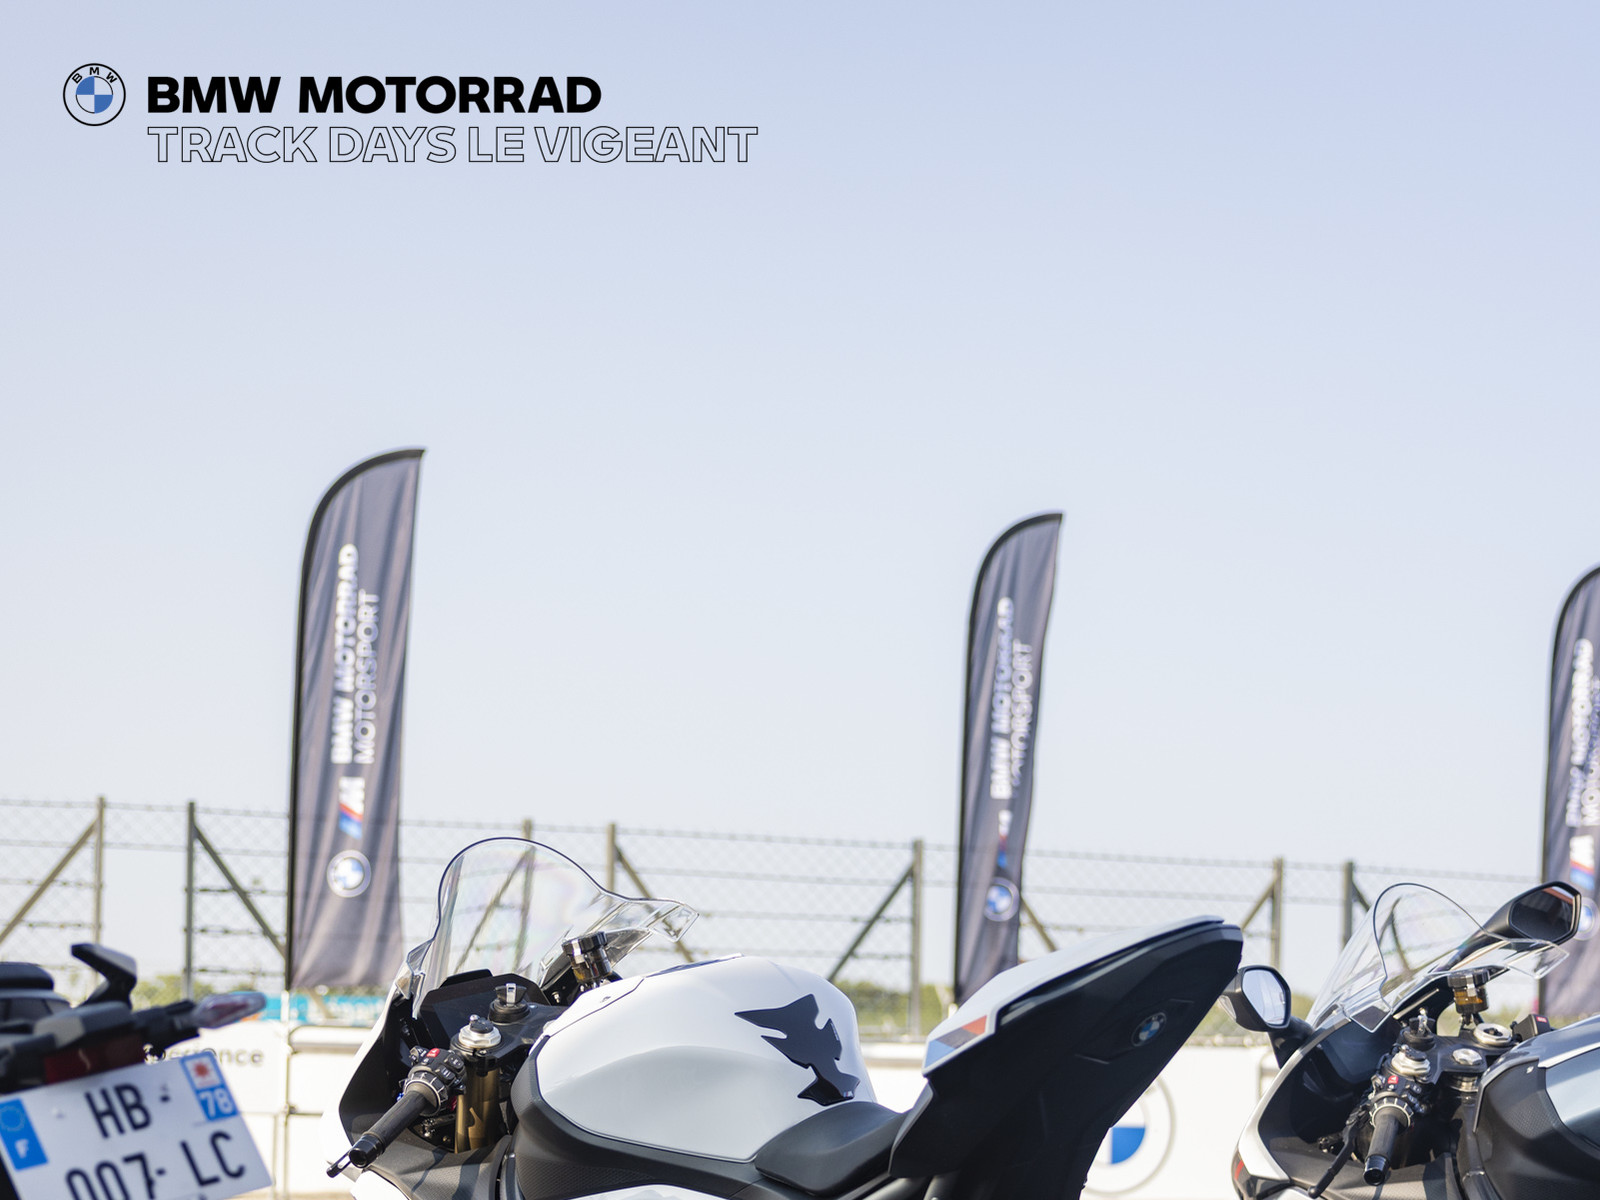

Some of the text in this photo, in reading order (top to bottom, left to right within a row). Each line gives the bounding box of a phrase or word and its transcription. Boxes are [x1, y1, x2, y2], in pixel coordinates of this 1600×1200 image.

[331, 543, 361, 764] BMW MOTORRAD
[353, 590, 380, 765] MOTORSPORT
[14, 1138, 30, 1159] F
[197, 1088, 236, 1118] 78
